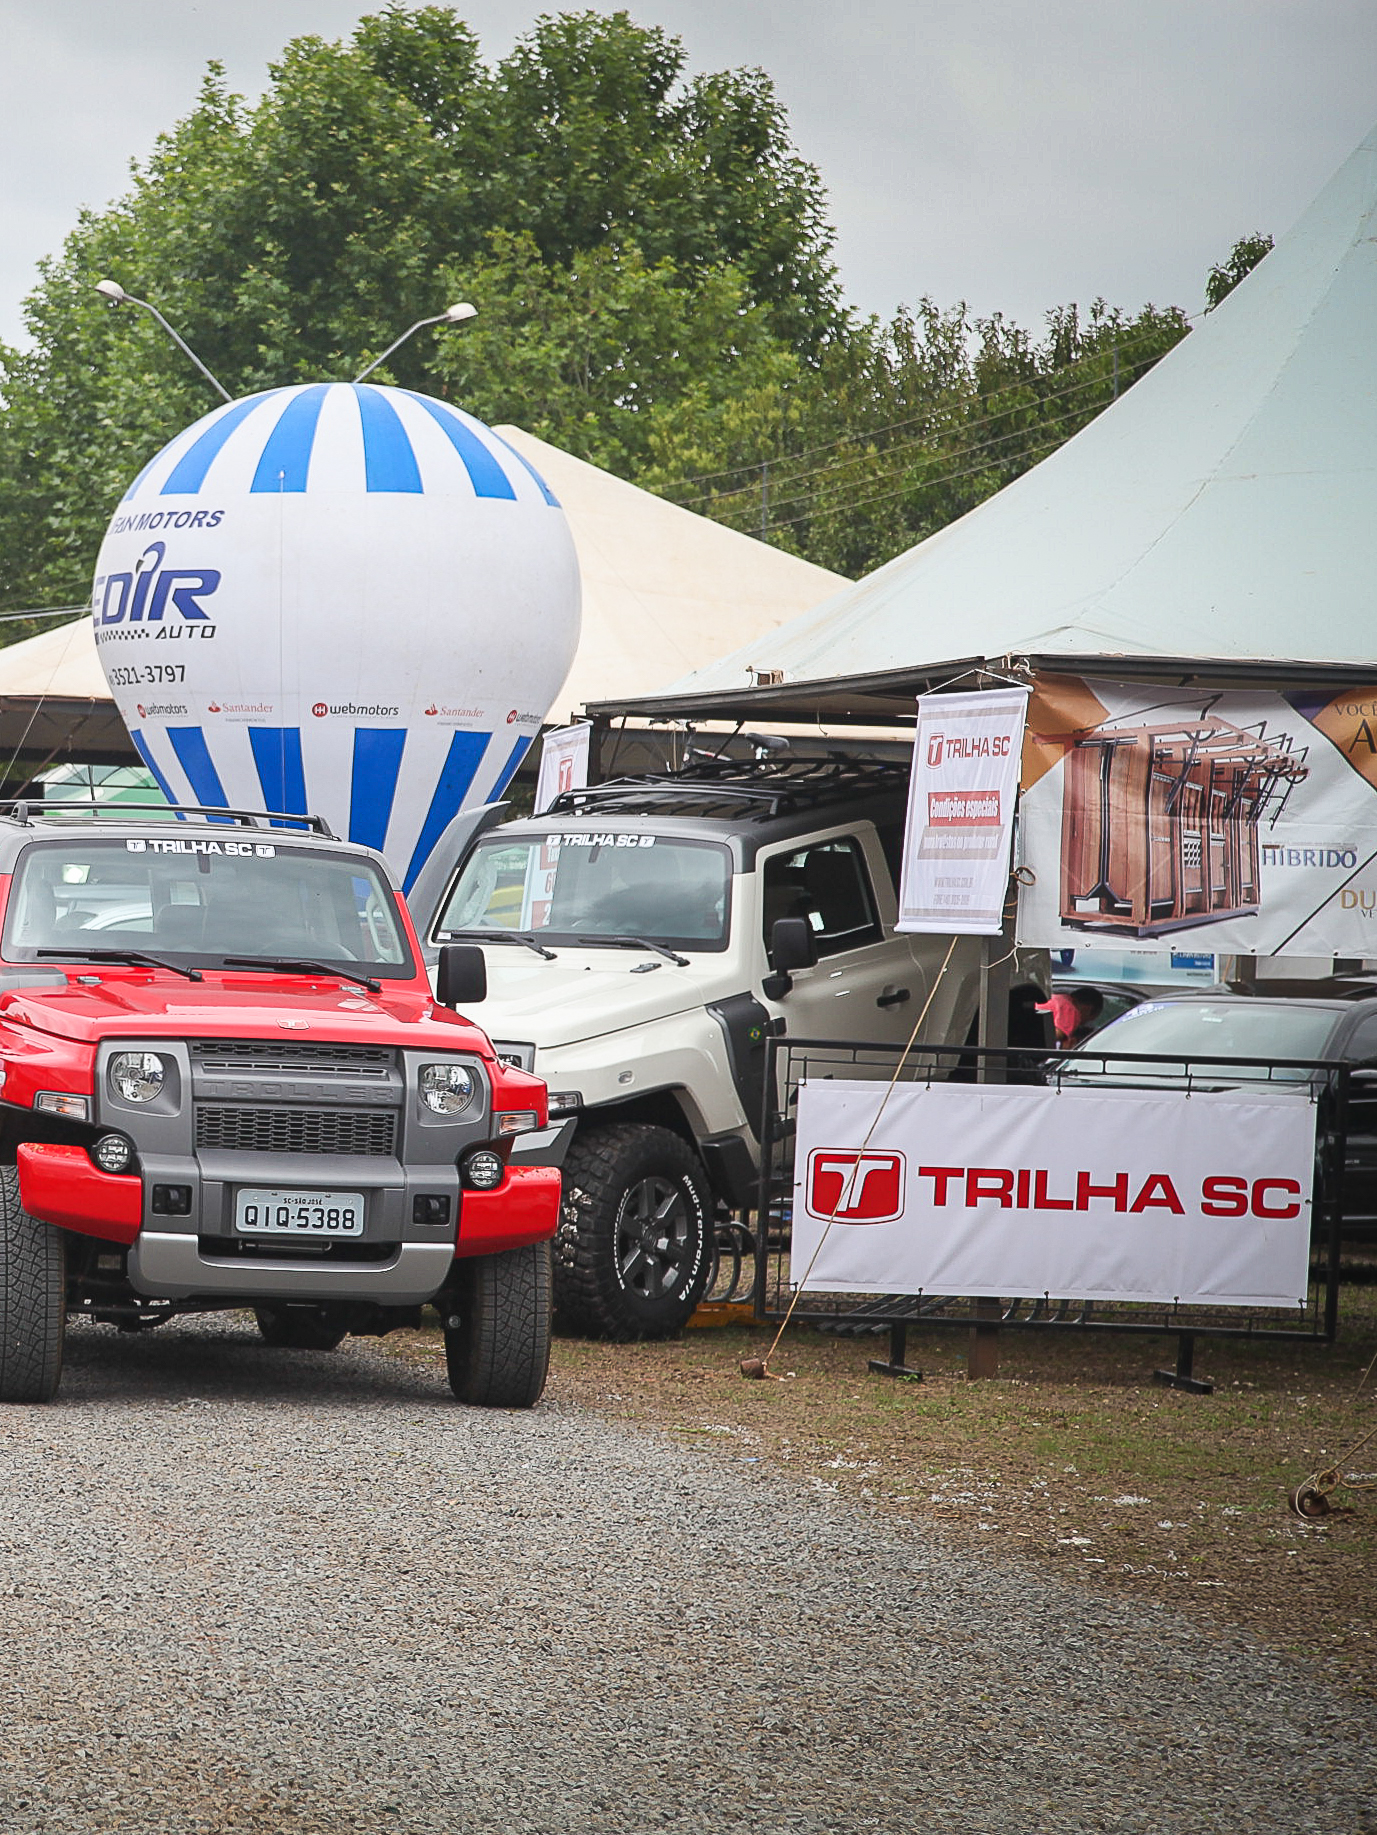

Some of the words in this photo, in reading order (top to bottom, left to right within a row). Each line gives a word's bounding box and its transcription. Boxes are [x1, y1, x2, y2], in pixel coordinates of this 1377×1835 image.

[135, 510, 225, 532] MOTORS
[155, 624, 217, 640] AUTO
[112, 664, 186, 686] 3521-3797
[222, 702, 274, 714] Santander
[329, 702, 400, 717] webmotors
[439, 703, 485, 718] Santander
[946, 737, 990, 758] TRILHA
[992, 735, 1011, 757] SC
[149, 840, 222, 855] TRILHA
[224, 843, 253, 857] SC
[564, 834, 615, 847] TRILHA
[616, 834, 639, 849] SC
[202, 1081, 394, 1100] TROLLER
[918, 1166, 1186, 1215] TRILHA
[1200, 1175, 1302, 1219] SC
